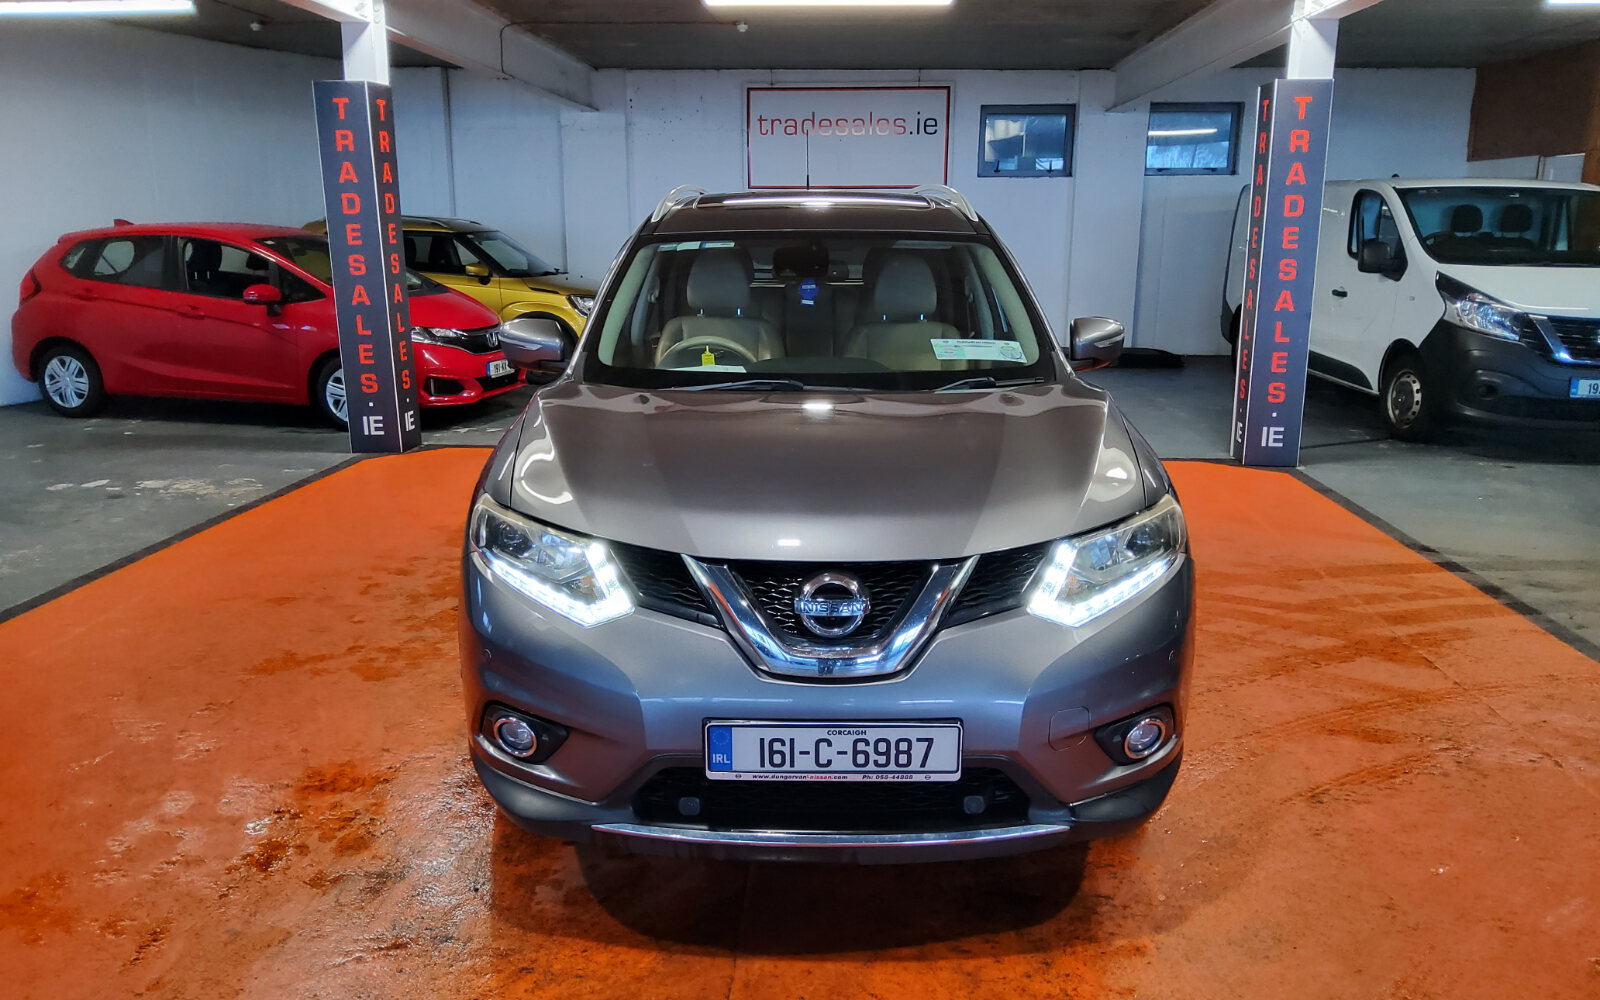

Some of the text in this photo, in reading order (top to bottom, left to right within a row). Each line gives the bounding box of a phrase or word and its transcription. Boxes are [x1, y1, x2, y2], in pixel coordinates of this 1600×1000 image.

[757, 111, 939, 136] tradesales.ie
[332, 97, 385, 436] TRADESALES.IE
[376, 98, 416, 432] TRADESALES.IE
[1261, 96, 1313, 447] TRADESALES.IE
[800, 601, 866, 613] NISSAN
[712, 754, 731, 764] IRL
[759, 737, 934, 769] 161-C-6987
